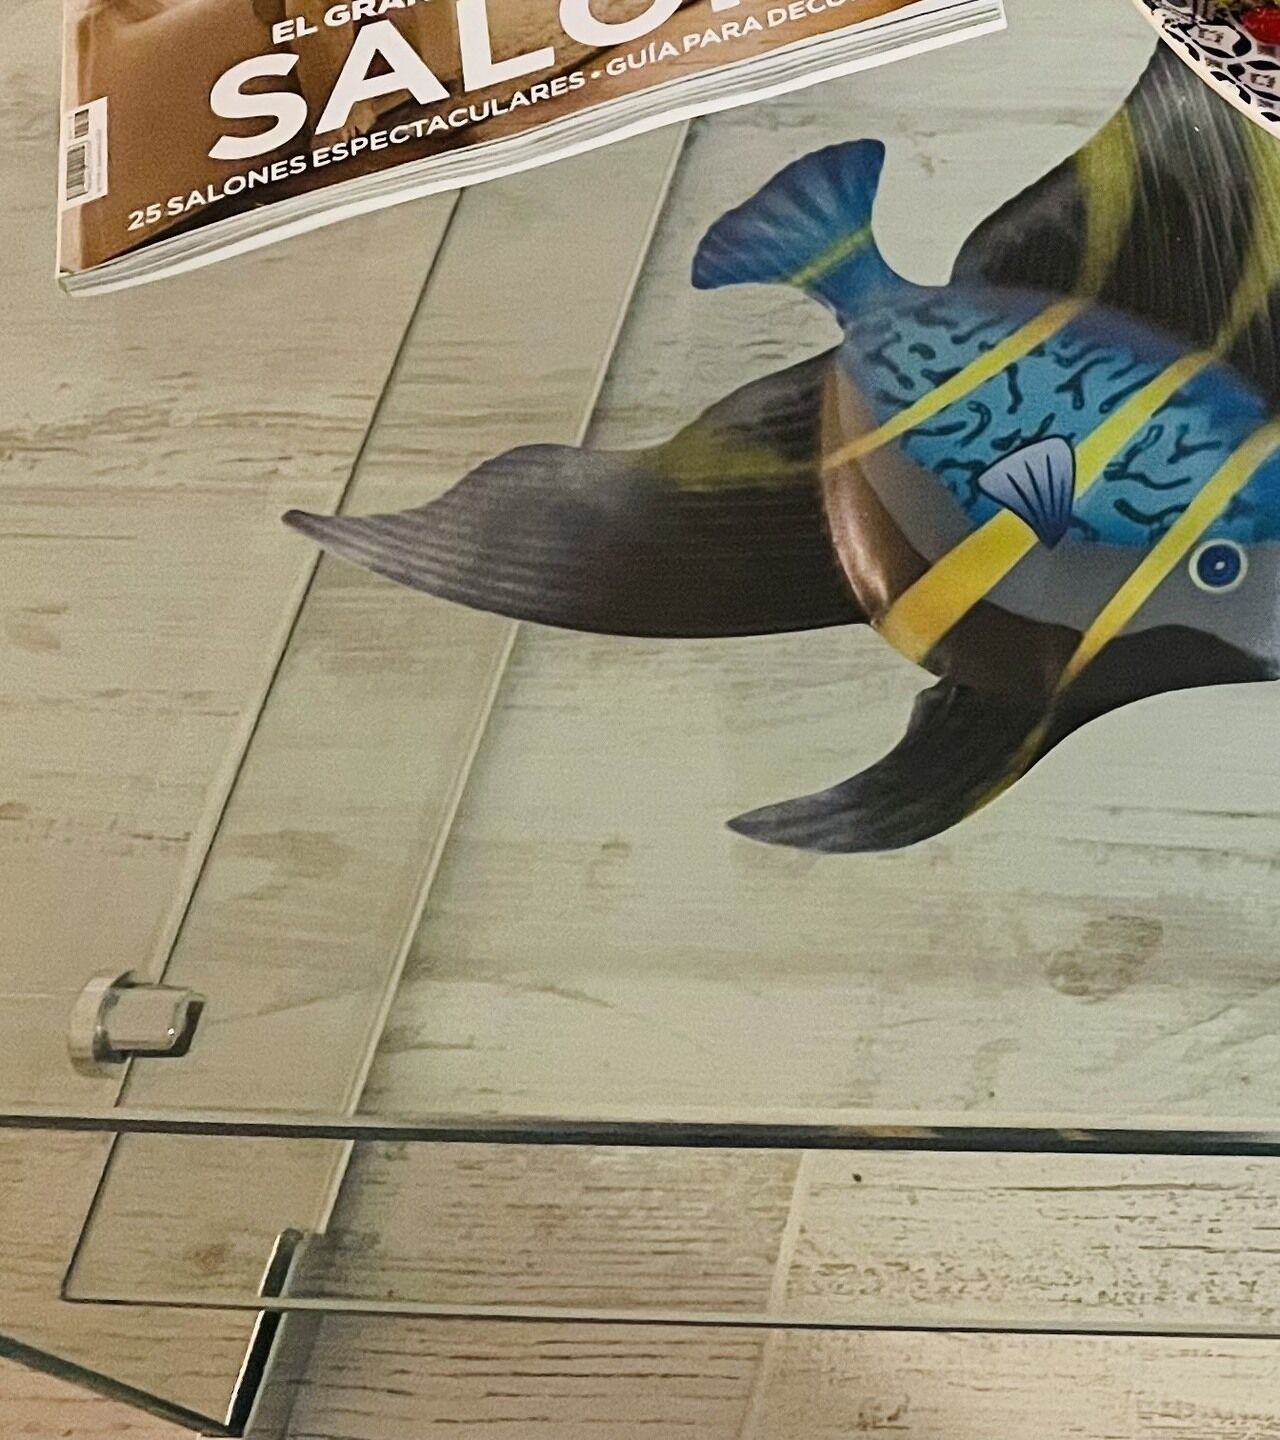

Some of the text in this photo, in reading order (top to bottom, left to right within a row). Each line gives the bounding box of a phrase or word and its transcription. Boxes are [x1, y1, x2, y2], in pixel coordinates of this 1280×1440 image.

[271, 18, 319, 45] EL
[126, 202, 163, 232] 25
[165, 158, 309, 219] SALONES
[310, 71, 588, 169] ESPECTACULARES
[603, 38, 681, 78] GUÍA
[681, 13, 764, 54] PARA
